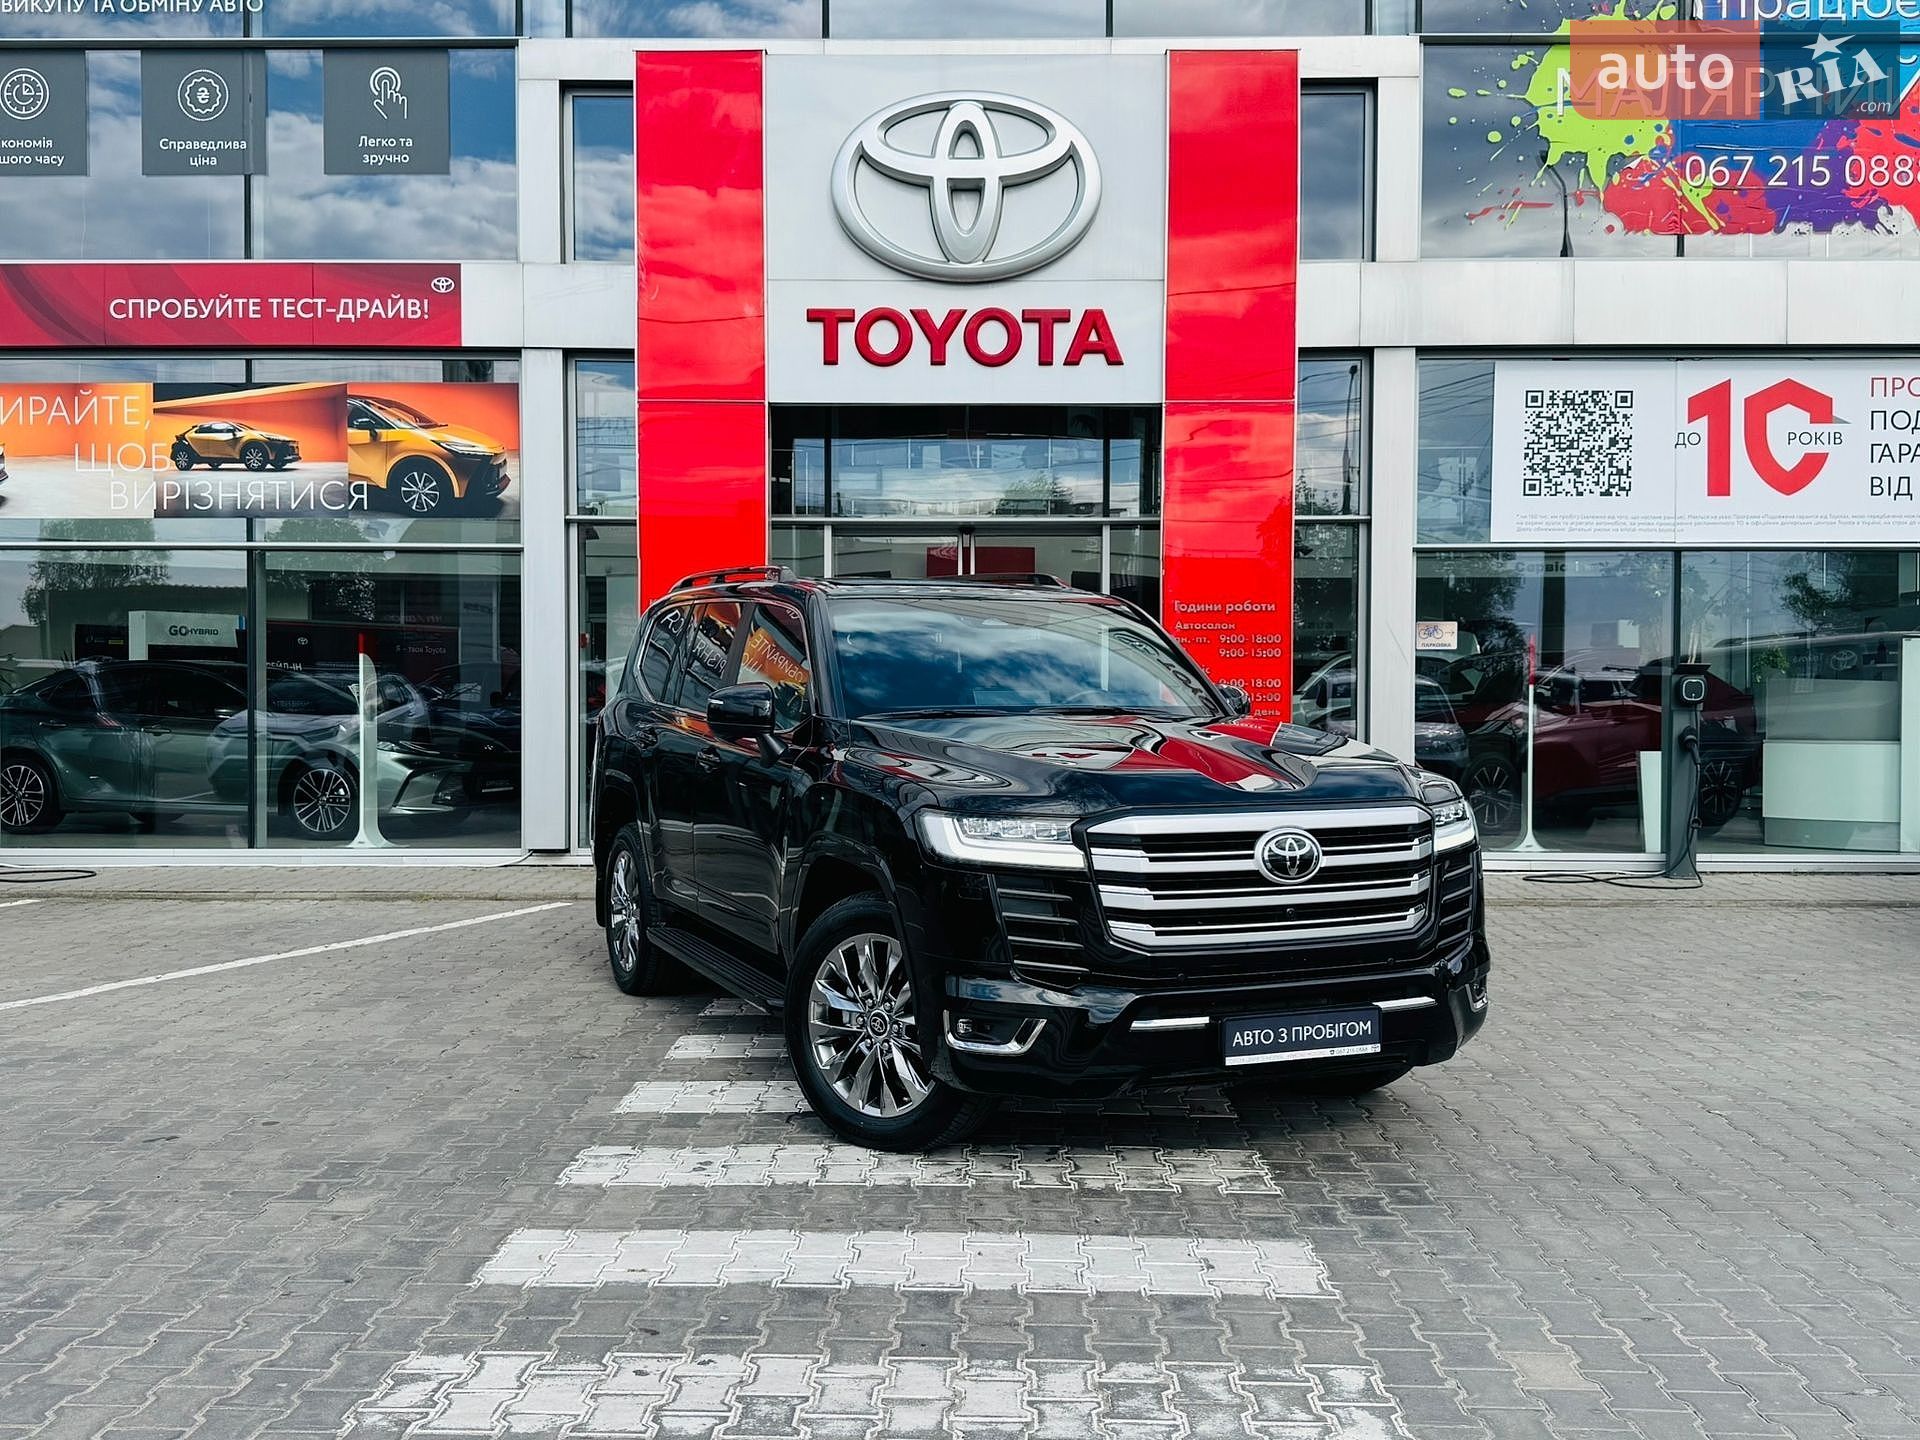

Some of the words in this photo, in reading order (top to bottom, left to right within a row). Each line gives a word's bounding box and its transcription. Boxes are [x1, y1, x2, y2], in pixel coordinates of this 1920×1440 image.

[120, 0, 202, 13] ОБМІНУ
[209, 0, 263, 13] АВТО
[1, 136, 53, 148] кономія
[159, 138, 247, 152] Справедлива
[358, 136, 396, 148] Легко
[399, 138, 413, 147] та
[35, 155, 65, 167] часу
[189, 155, 217, 167] ціна
[362, 153, 409, 166] зручно
[1685, 154, 1754, 187] 067
[1767, 154, 1831, 187] 215
[1845, 154, 1920, 187] 088
[109, 293, 261, 320] СПРОБУЙТЕ
[268, 293, 429, 323] ТЕСТ-ДРАЙВ!
[806, 306, 1124, 367] TOYOTA
[1674, 431, 1701, 449] ДО
[1787, 431, 1843, 446] РОКІВ
[74, 442, 171, 475] ЩОБ
[110, 480, 368, 511] ВИРІЗНЯТИСЯ
[1870, 476, 1913, 501] ВІД
[1174, 600, 1223, 613] Години
[1225, 600, 1276, 614] роботи
[1174, 620, 1236, 630] Автосалон
[1232, 1029, 1274, 1047] АВТО
[1291, 1020, 1373, 1042] ПРОБІГОМ
